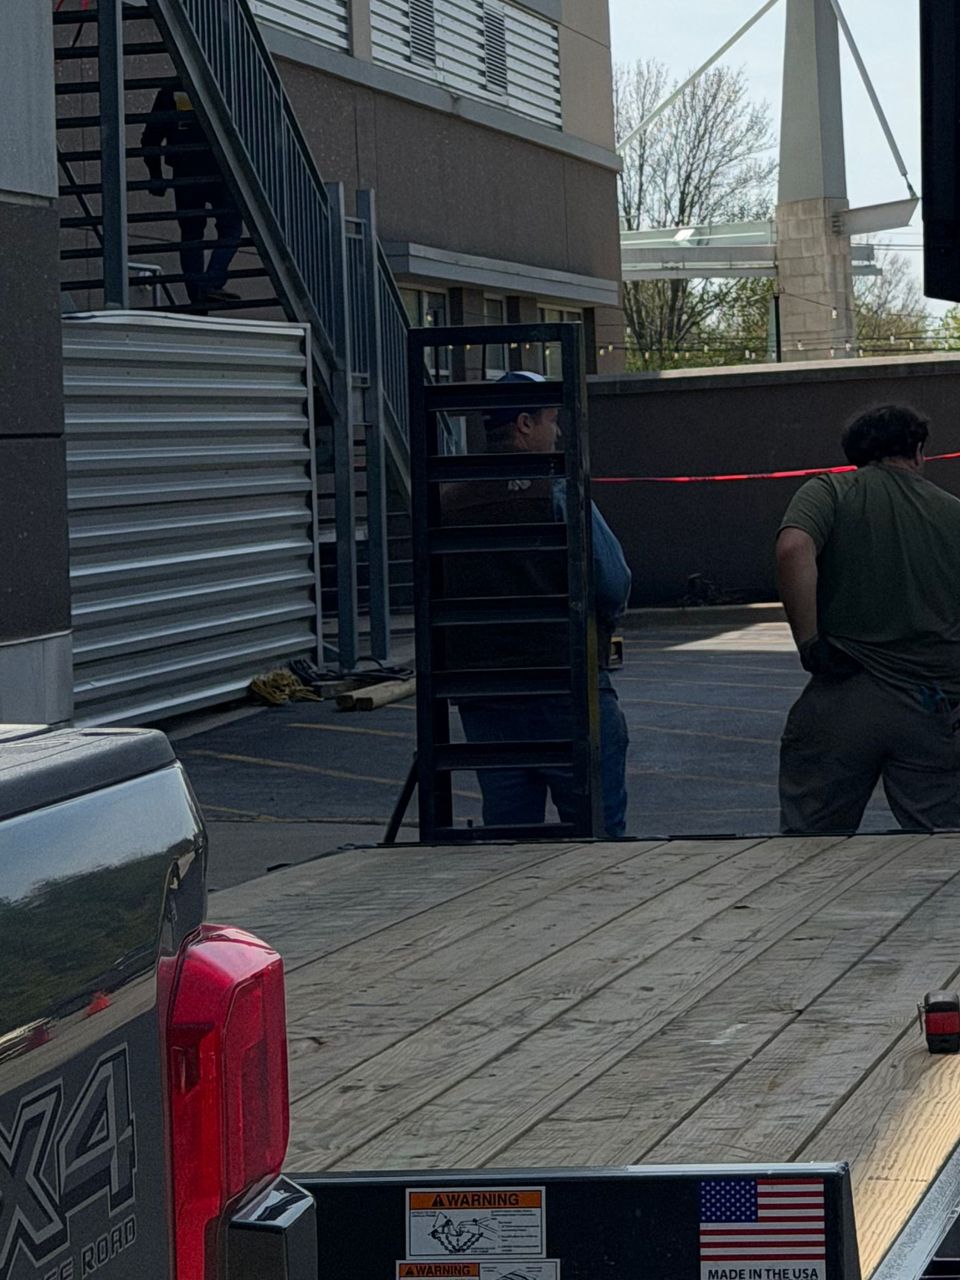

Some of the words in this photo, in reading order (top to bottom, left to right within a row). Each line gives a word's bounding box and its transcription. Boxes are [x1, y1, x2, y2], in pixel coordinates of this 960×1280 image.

[446, 1193, 519, 1207] WARNING
[81, 1213, 136, 1280] ROAD
[416, 1265, 470, 1276] WARNING
[708, 1269, 745, 1280] MADE
[749, 1268, 762, 1280] IN
[765, 1268, 789, 1279] THE
[793, 1268, 819, 1279] USA
